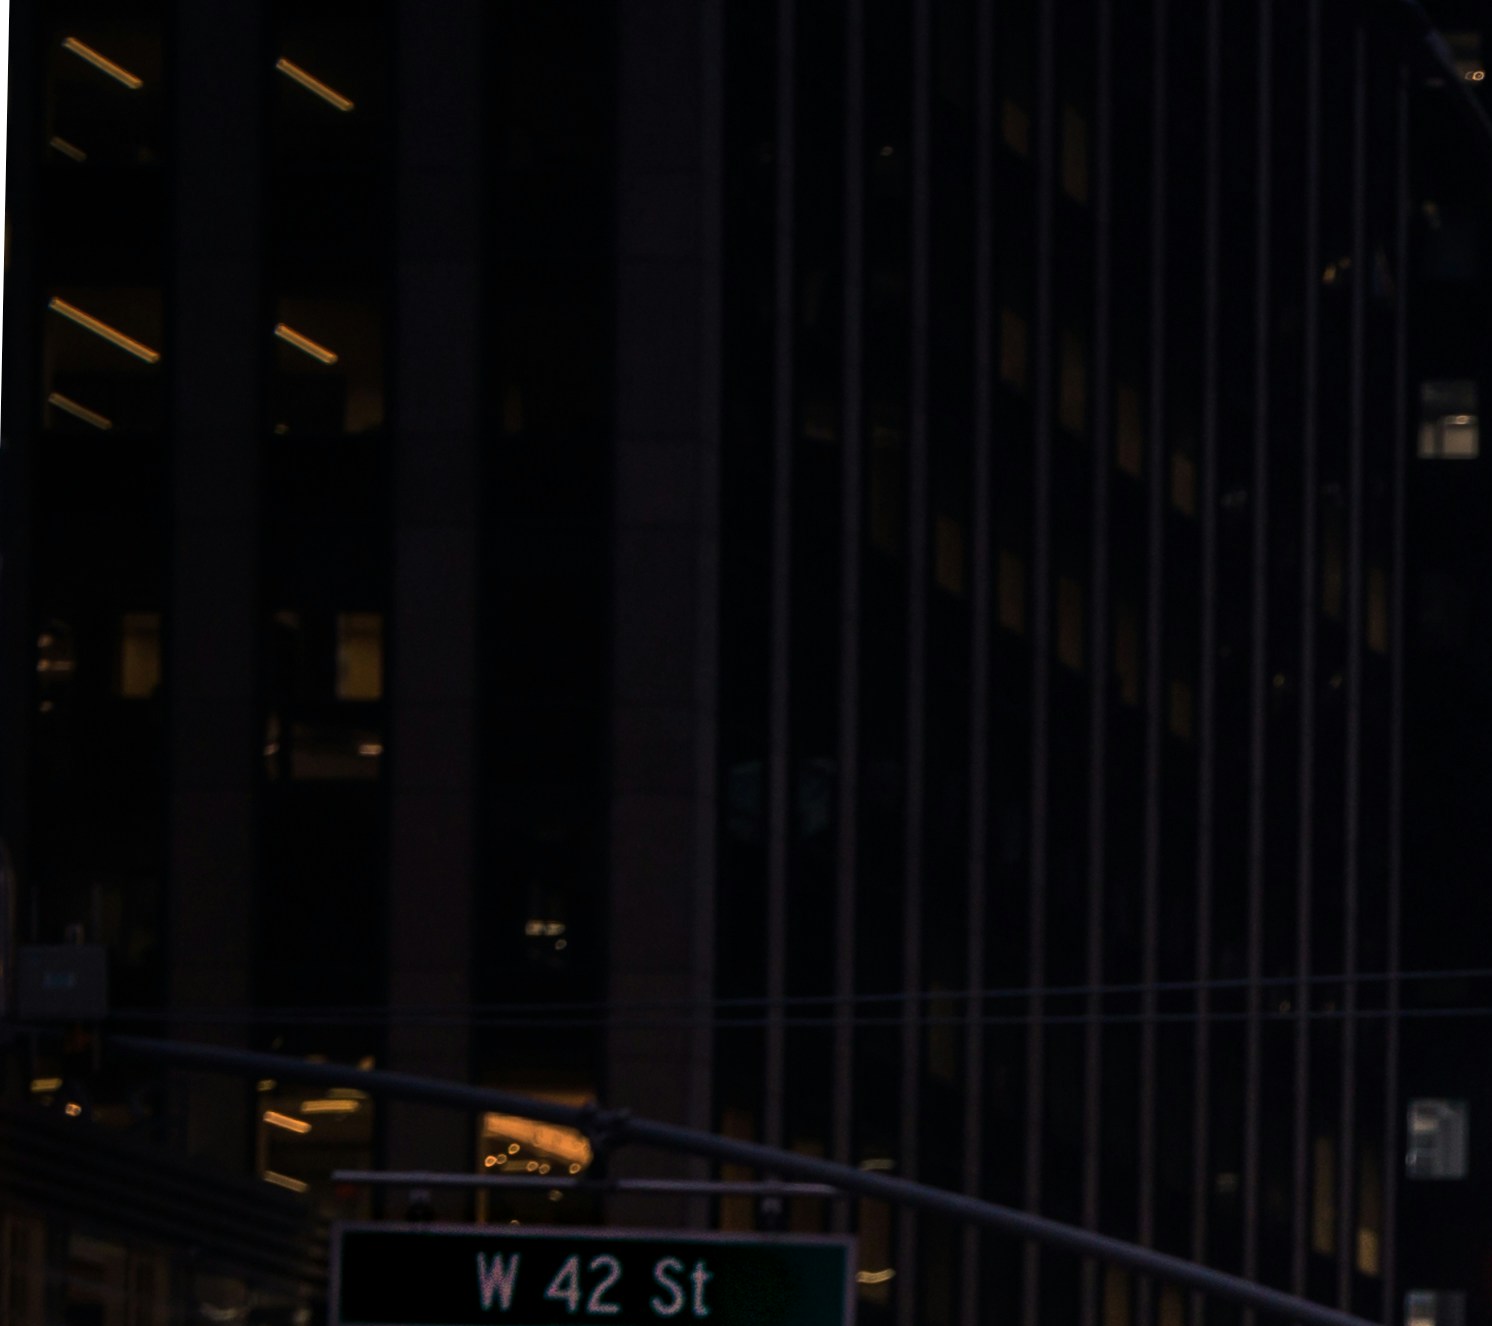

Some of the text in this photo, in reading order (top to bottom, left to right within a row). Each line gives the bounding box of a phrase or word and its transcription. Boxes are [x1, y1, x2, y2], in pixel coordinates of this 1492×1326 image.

[477, 1253, 709, 1316] W 42 St
